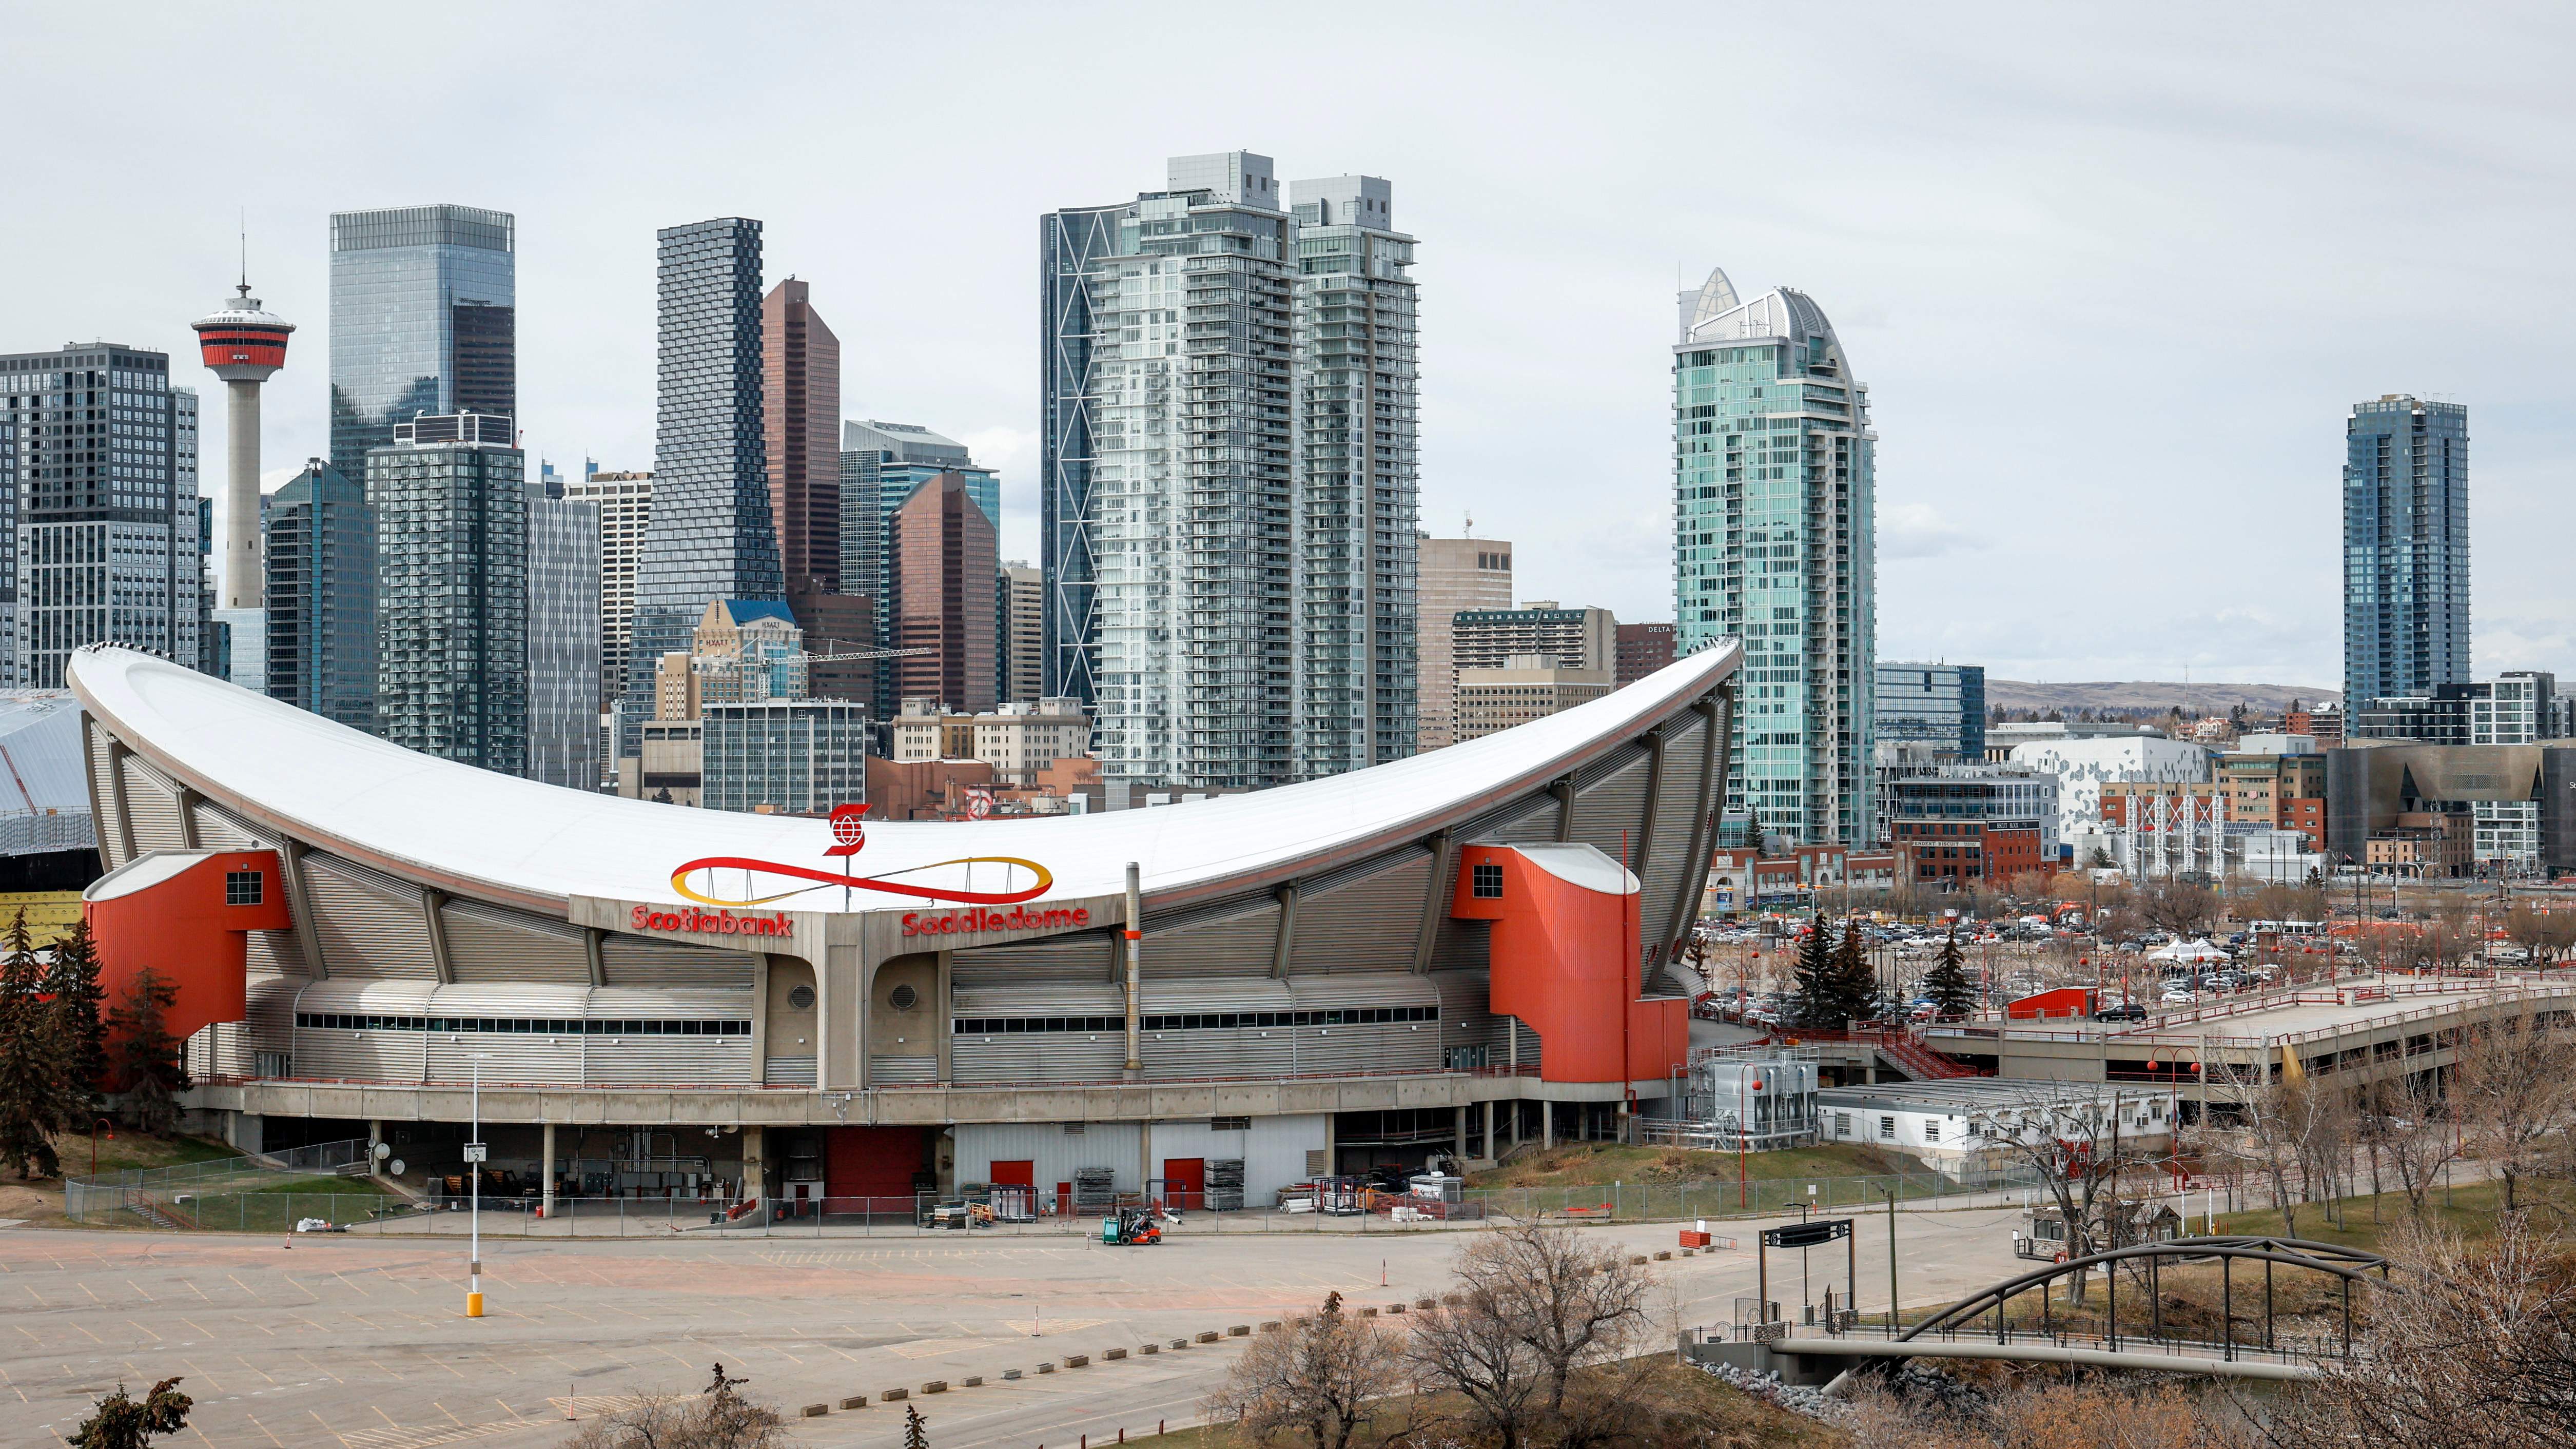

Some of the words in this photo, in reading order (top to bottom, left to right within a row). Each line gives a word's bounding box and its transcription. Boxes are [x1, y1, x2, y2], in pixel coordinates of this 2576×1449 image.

[706, 639, 728, 647] HYATT
[632, 905, 793, 937] Scotiabank
[902, 905, 1089, 936] Saddledome
